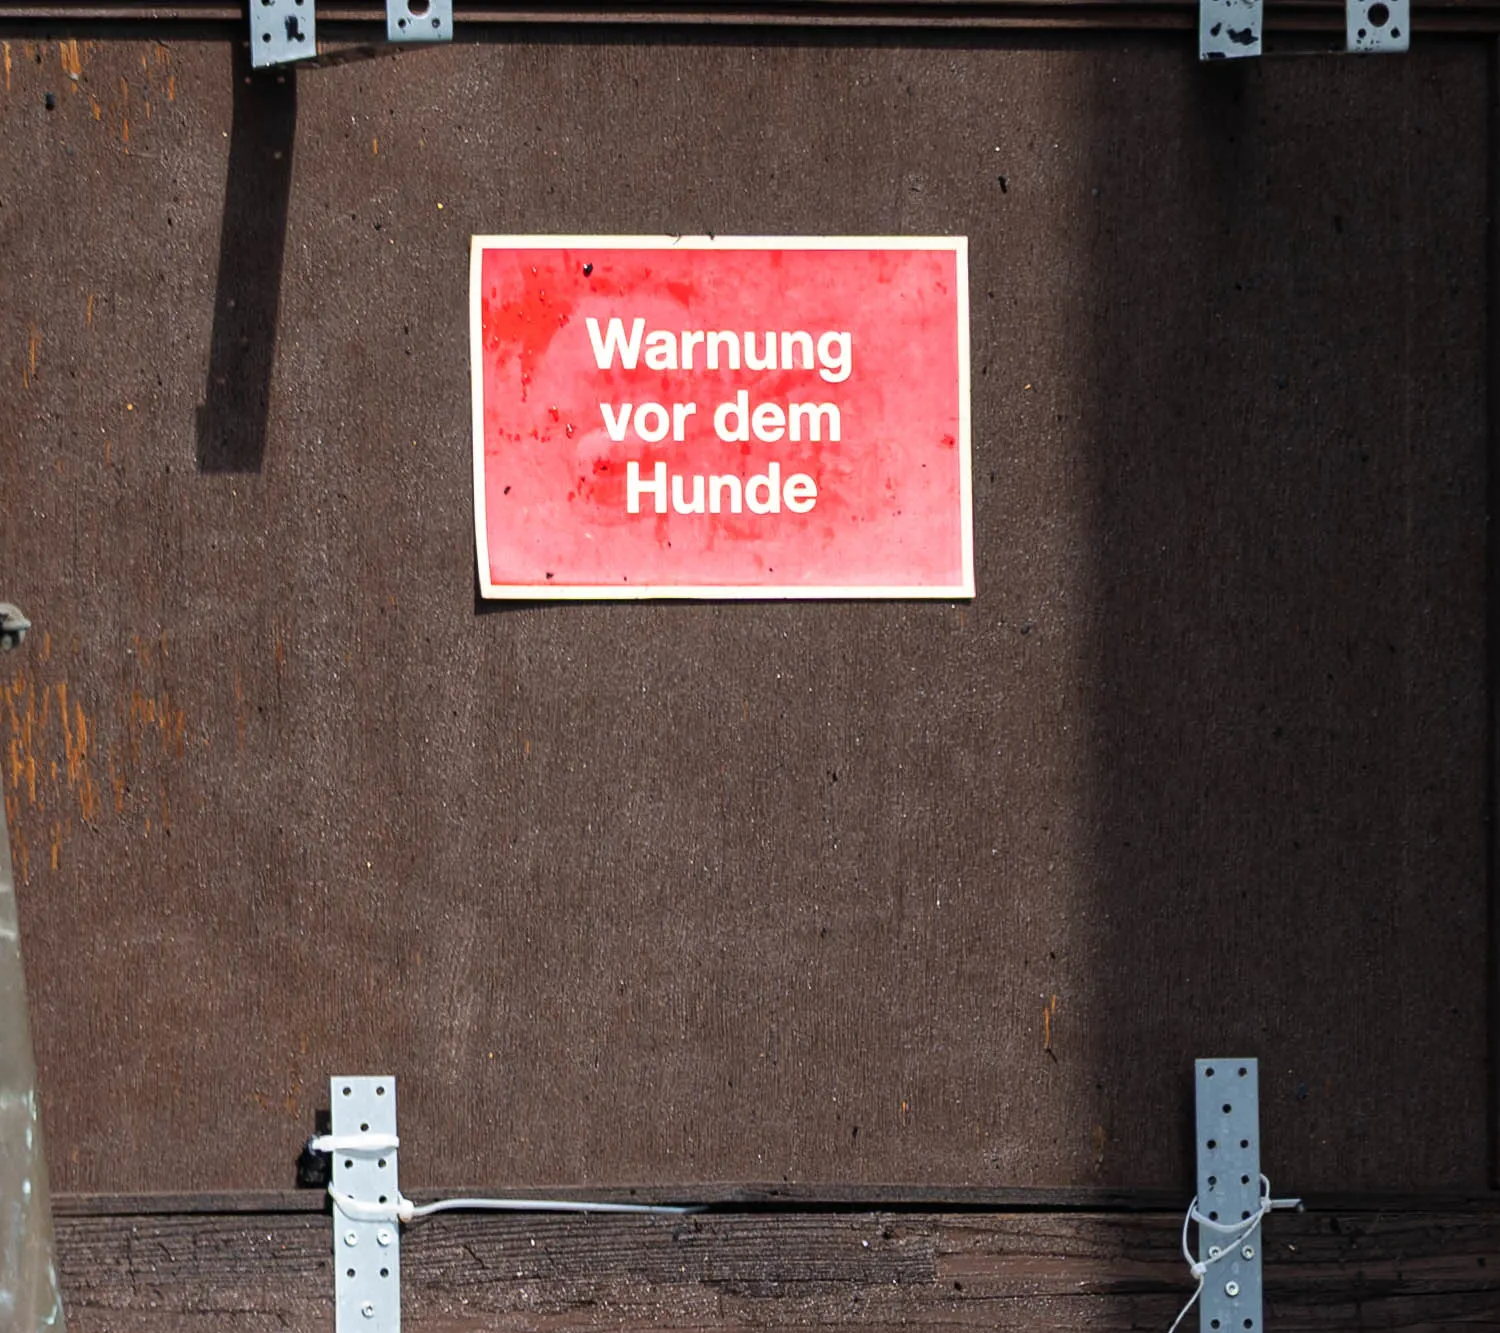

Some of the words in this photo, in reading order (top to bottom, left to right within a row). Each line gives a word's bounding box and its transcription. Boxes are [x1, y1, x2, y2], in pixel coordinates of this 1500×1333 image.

[586, 316, 853, 383] Warnung
[600, 400, 697, 443] vor
[713, 389, 842, 443] dem
[625, 461, 819, 515] Hunde
